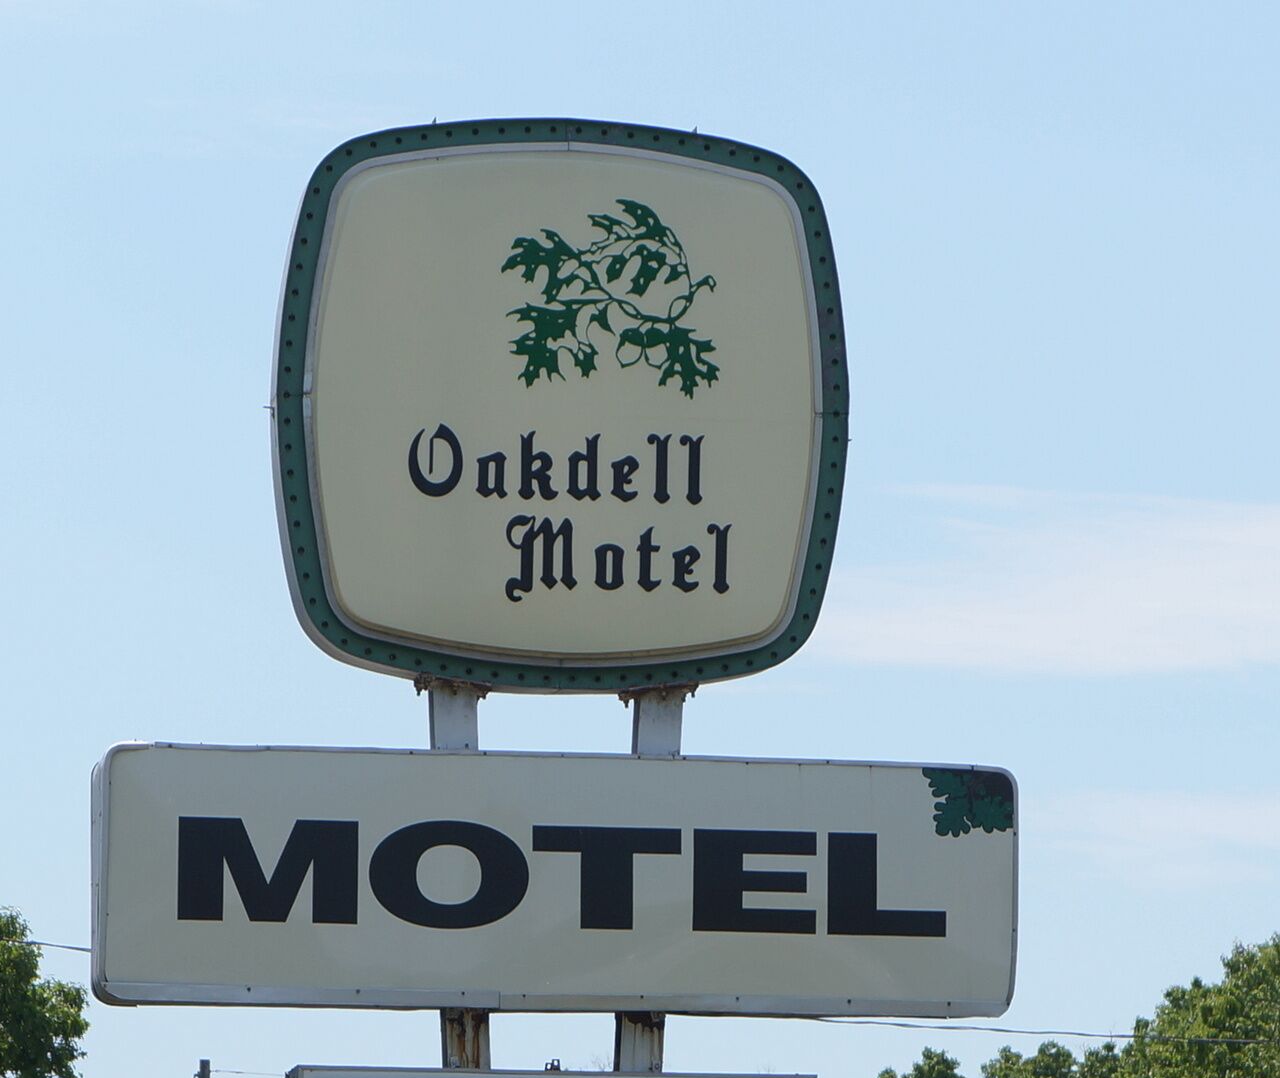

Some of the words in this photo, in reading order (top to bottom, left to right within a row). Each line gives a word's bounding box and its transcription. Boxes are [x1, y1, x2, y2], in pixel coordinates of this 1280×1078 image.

[408, 423, 705, 505] Oakdell
[505, 514, 732, 603] Motel
[177, 816, 947, 938] MOTEL
